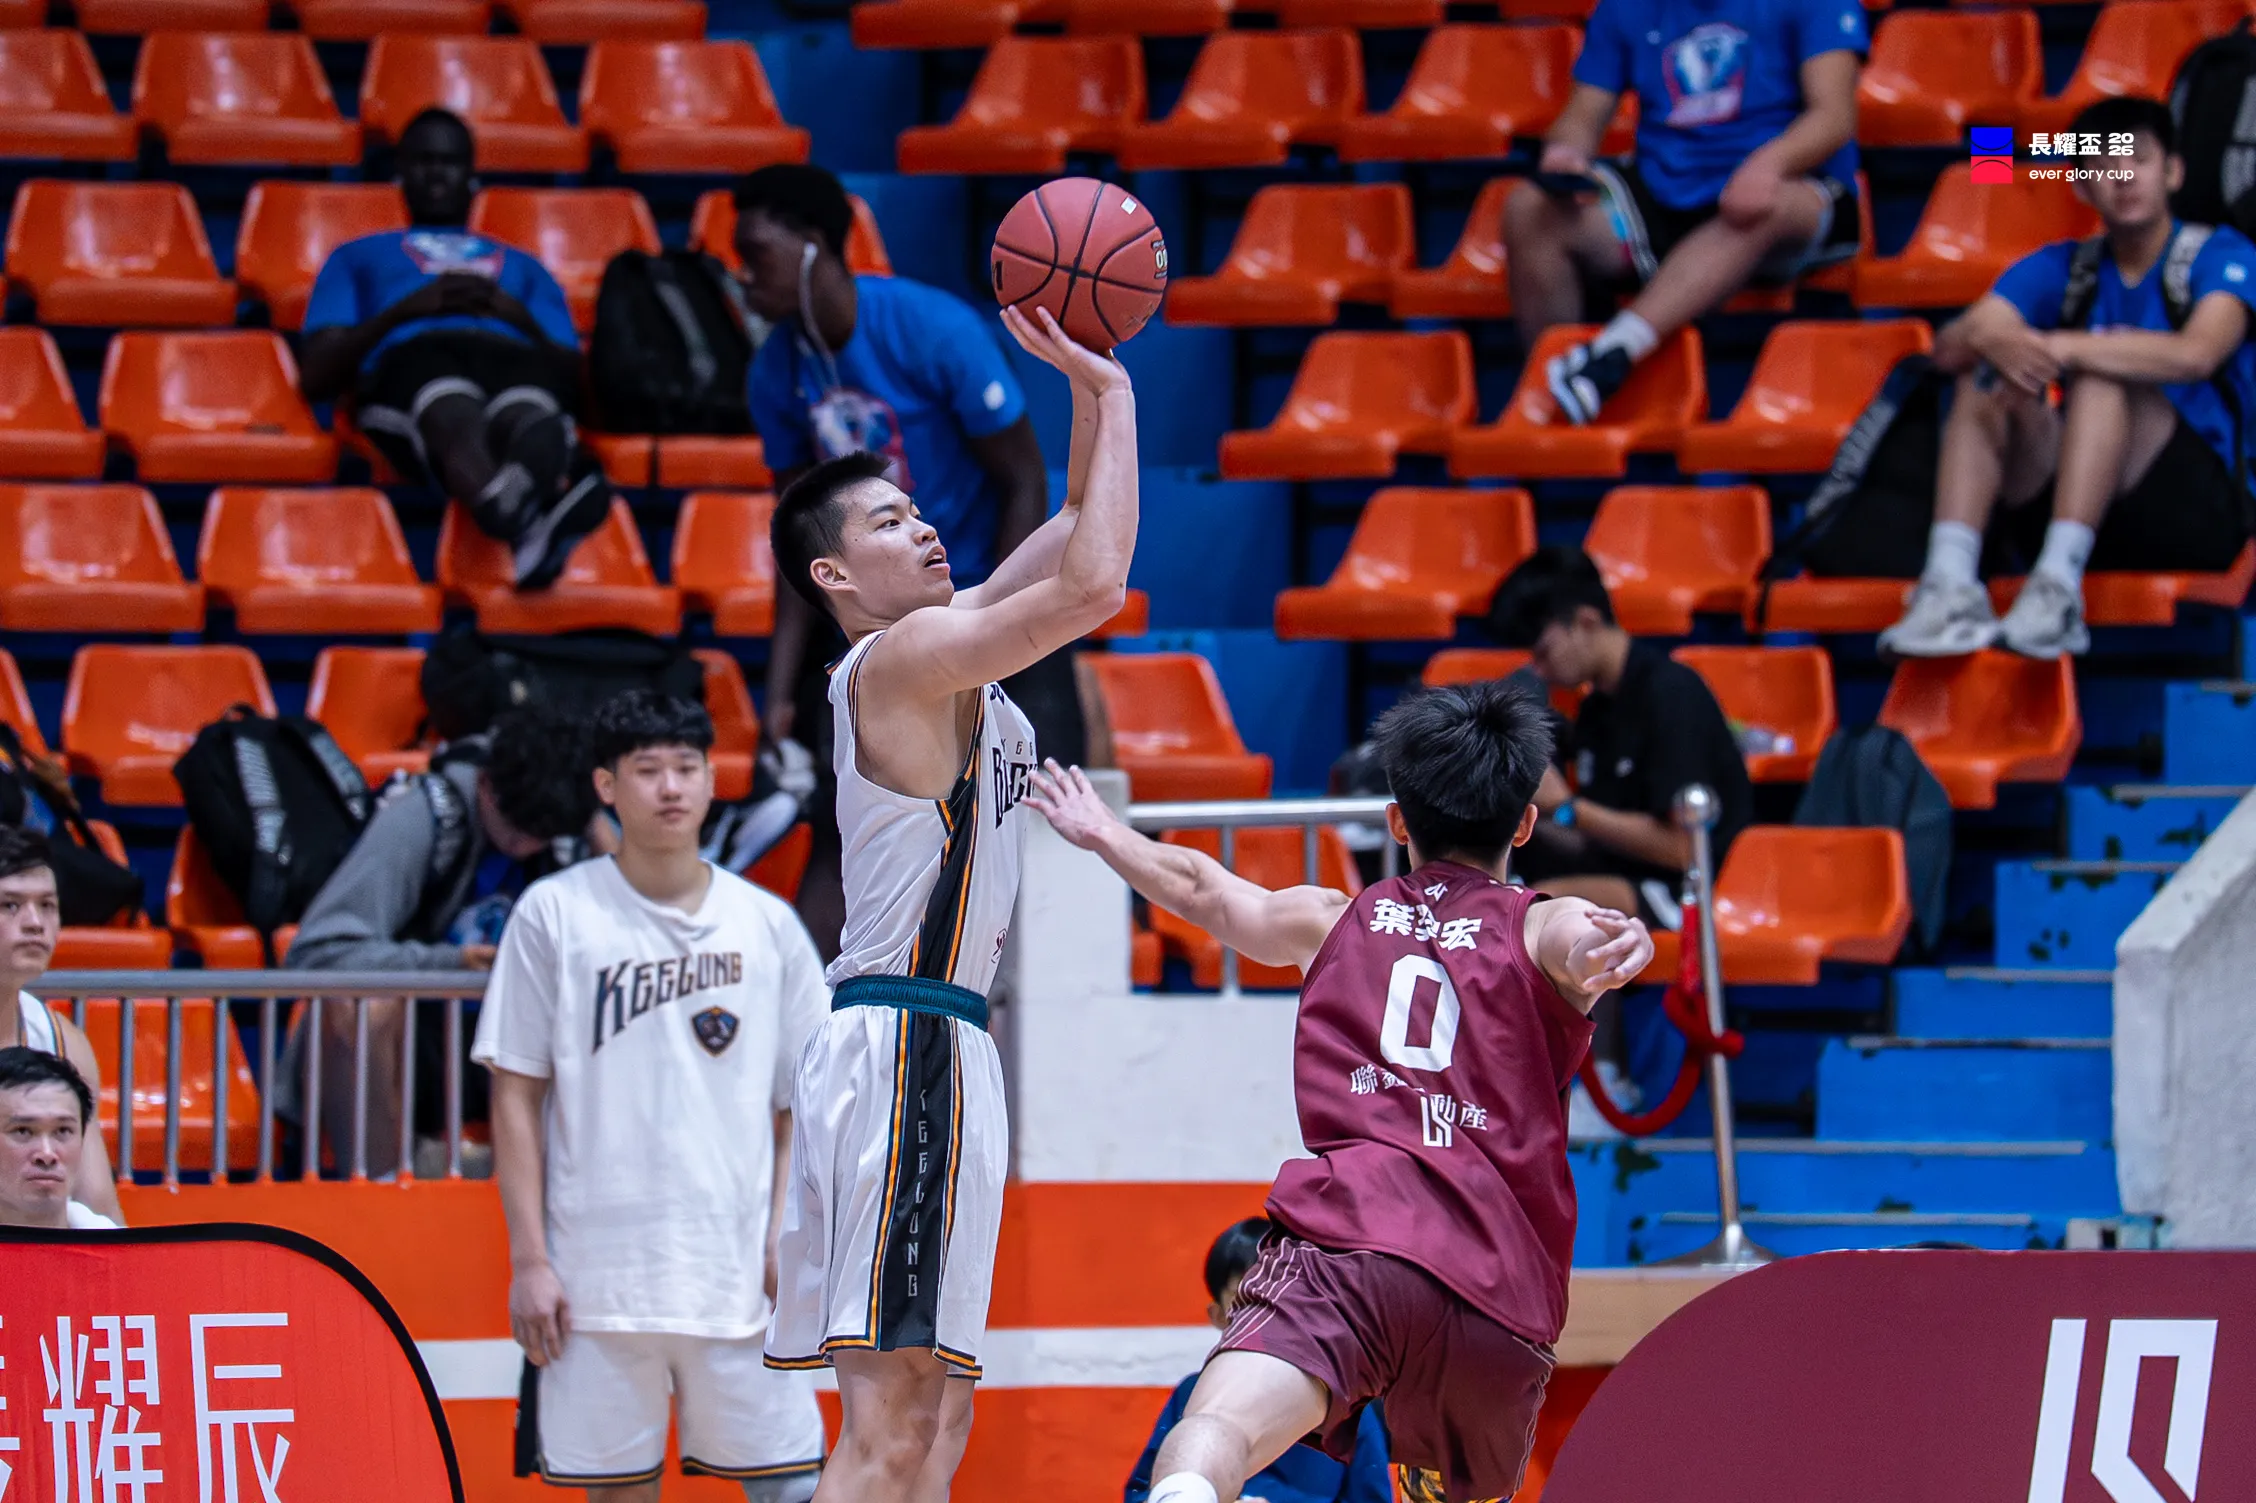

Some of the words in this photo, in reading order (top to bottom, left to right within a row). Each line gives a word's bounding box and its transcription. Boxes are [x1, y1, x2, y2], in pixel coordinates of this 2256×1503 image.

[591, 951, 743, 1055] KEELUNG
[1380, 954, 1461, 1072] 0
[0, 1312, 295, 1503] 耀辰
